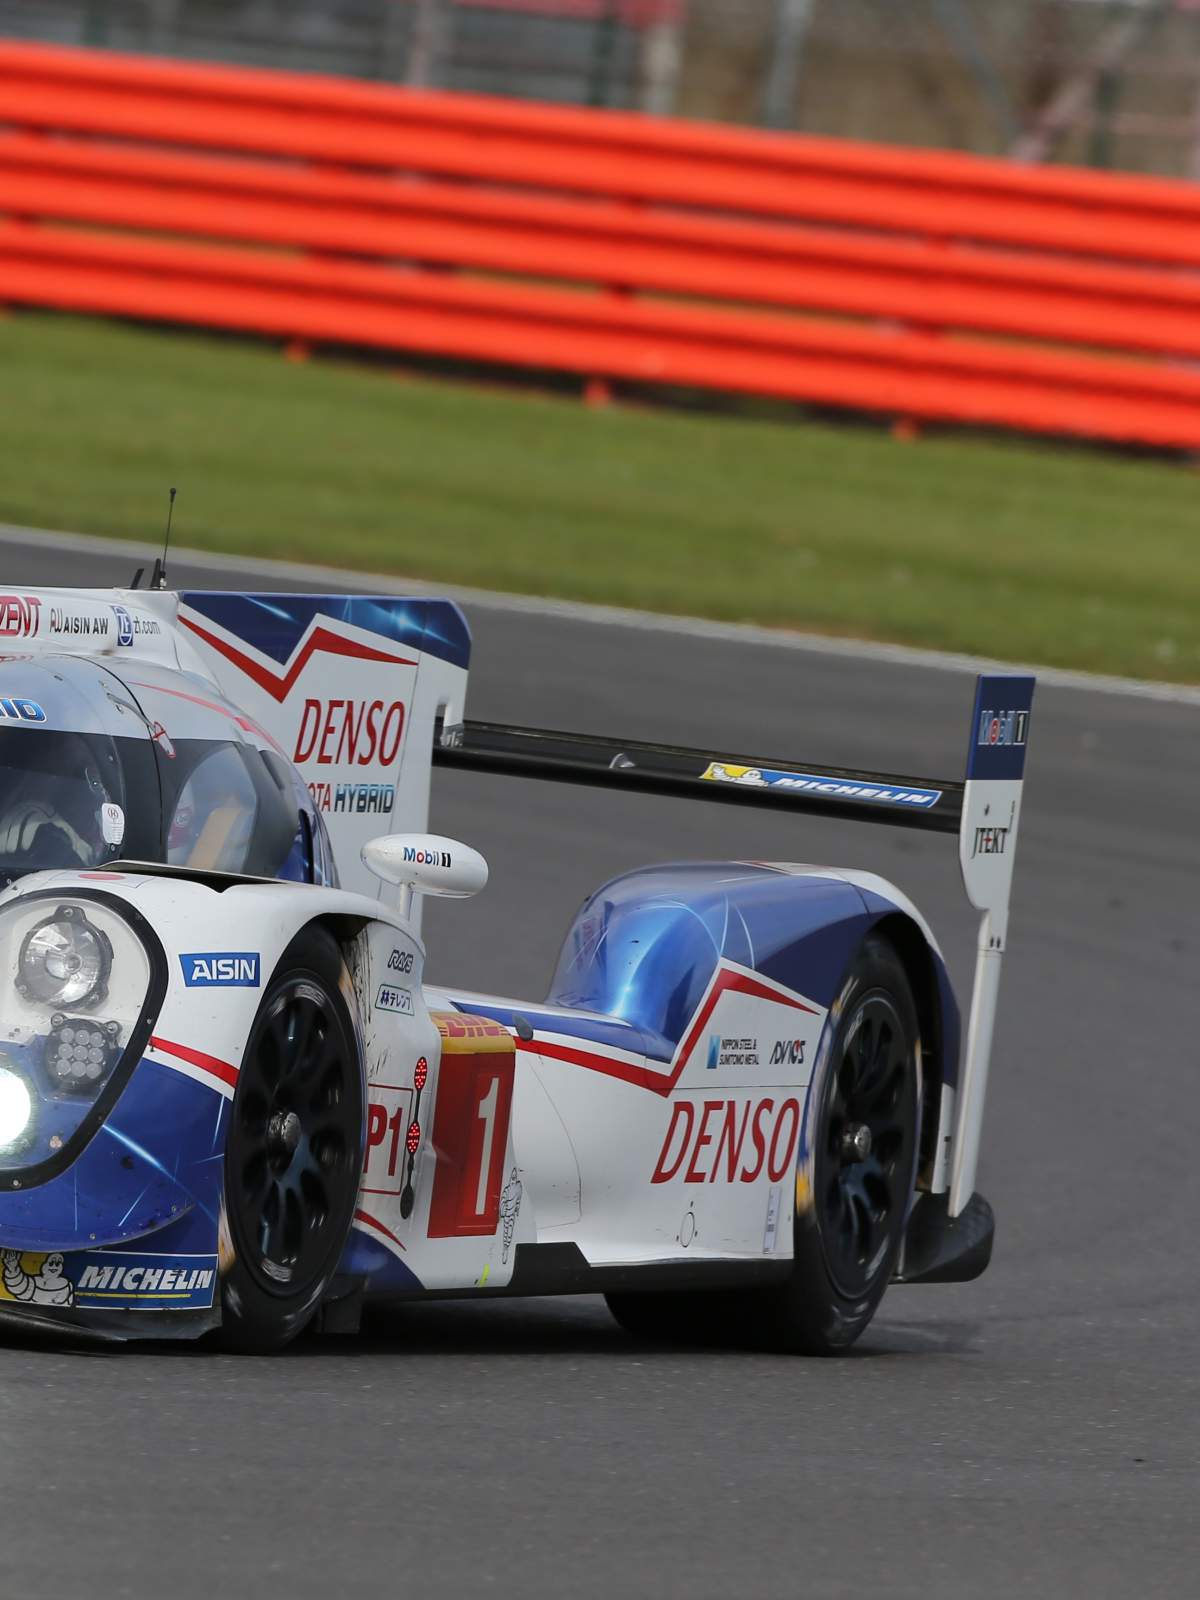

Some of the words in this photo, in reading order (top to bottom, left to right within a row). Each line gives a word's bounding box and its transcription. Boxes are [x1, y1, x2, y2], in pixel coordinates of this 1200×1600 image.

[64, 617, 90, 634] AISIN
[93, 617, 109, 634] AW
[293, 699, 405, 766] DENSO
[334, 784, 395, 813] HYBRID
[773, 777, 932, 804] MICHELIN
[403, 847, 439, 866] Mobil
[971, 827, 1008, 859] JTEKT
[191, 959, 256, 980] AISIN
[739, 1039, 752, 1050] STEEL
[363, 1104, 402, 1176] P1
[475, 1077, 499, 1215] 1
[650, 1098, 799, 1184] DENSO
[77, 1265, 213, 1290] MICHELIN
